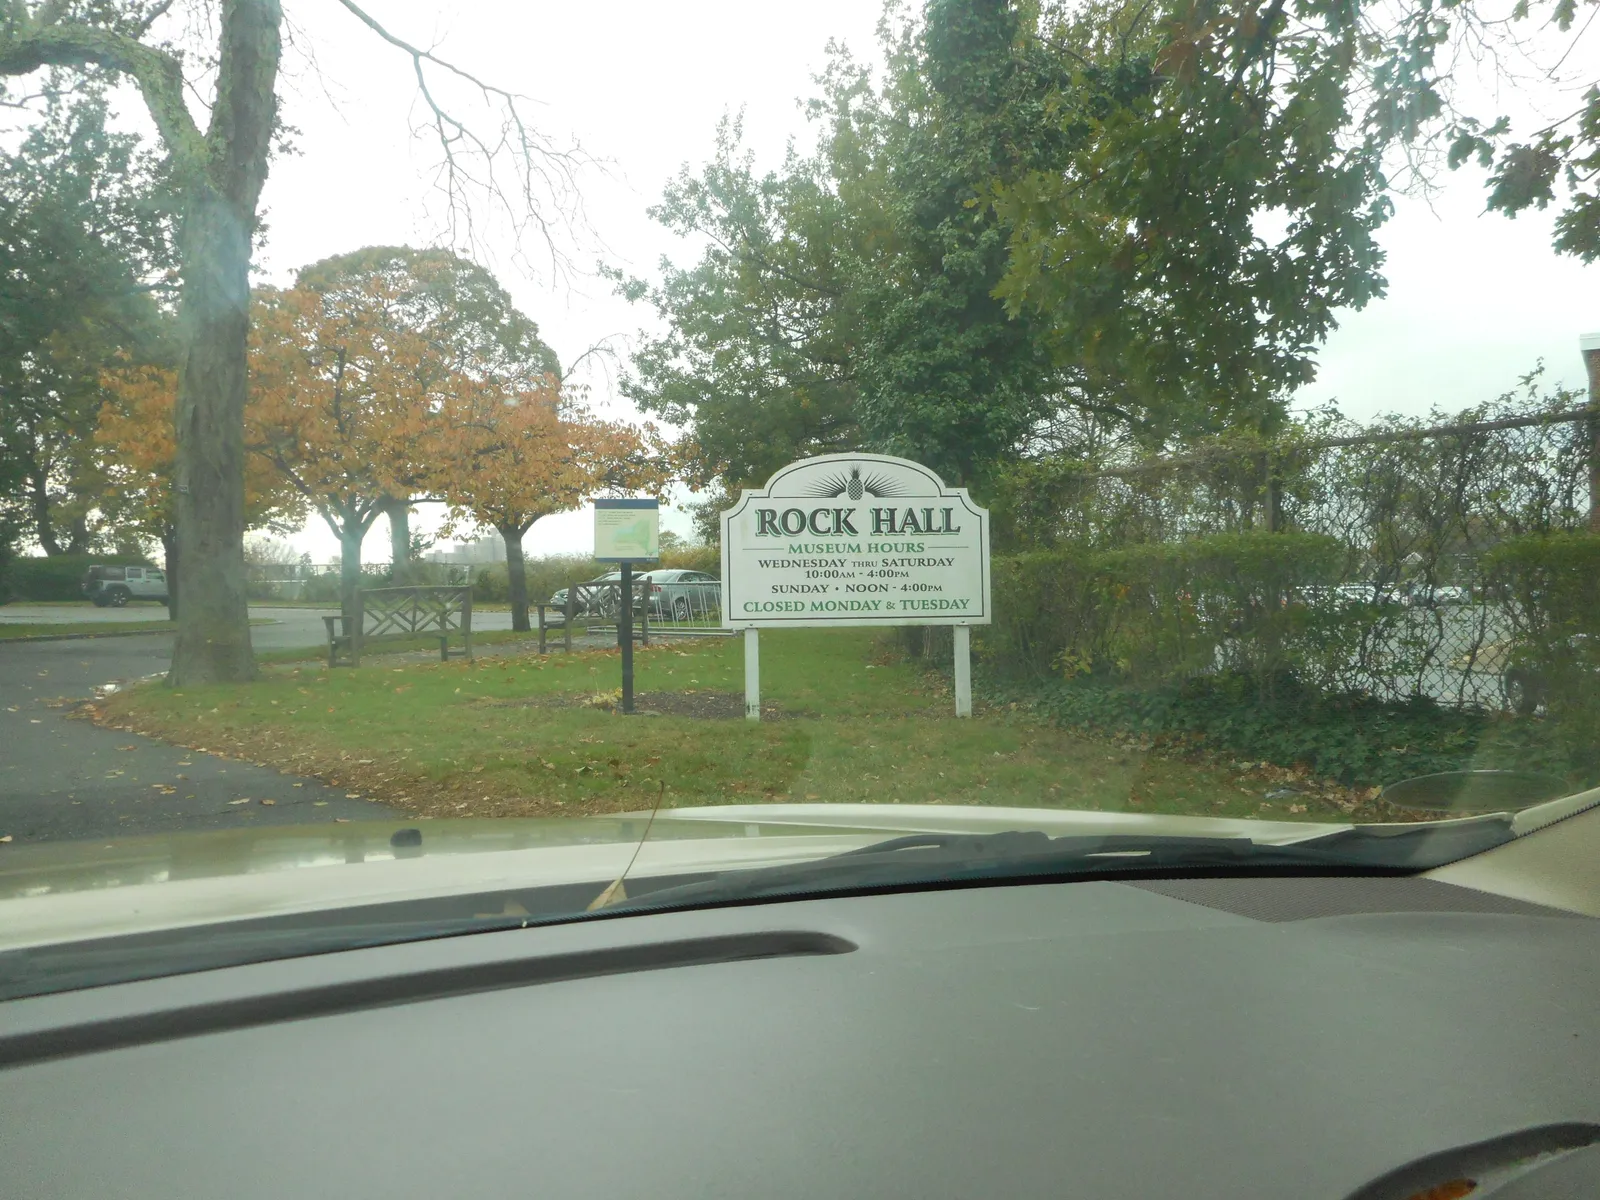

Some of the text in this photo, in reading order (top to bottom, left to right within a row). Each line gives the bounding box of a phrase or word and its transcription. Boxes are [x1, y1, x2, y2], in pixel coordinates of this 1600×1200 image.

[755, 507, 961, 537] ROCK HALL
[788, 542, 925, 554] MUSEUM HOURS
[758, 558, 955, 569] WEDNESDAY THRU SATURDAY
[804, 569, 856, 579] 10:00AM
[866, 569, 909, 579] 4:00PM
[771, 584, 830, 594] SUNDAY
[845, 583, 889, 593] NOON
[900, 583, 943, 593] 4:00PM
[743, 599, 970, 613] CLOSED MONDAY & TUESDAY
